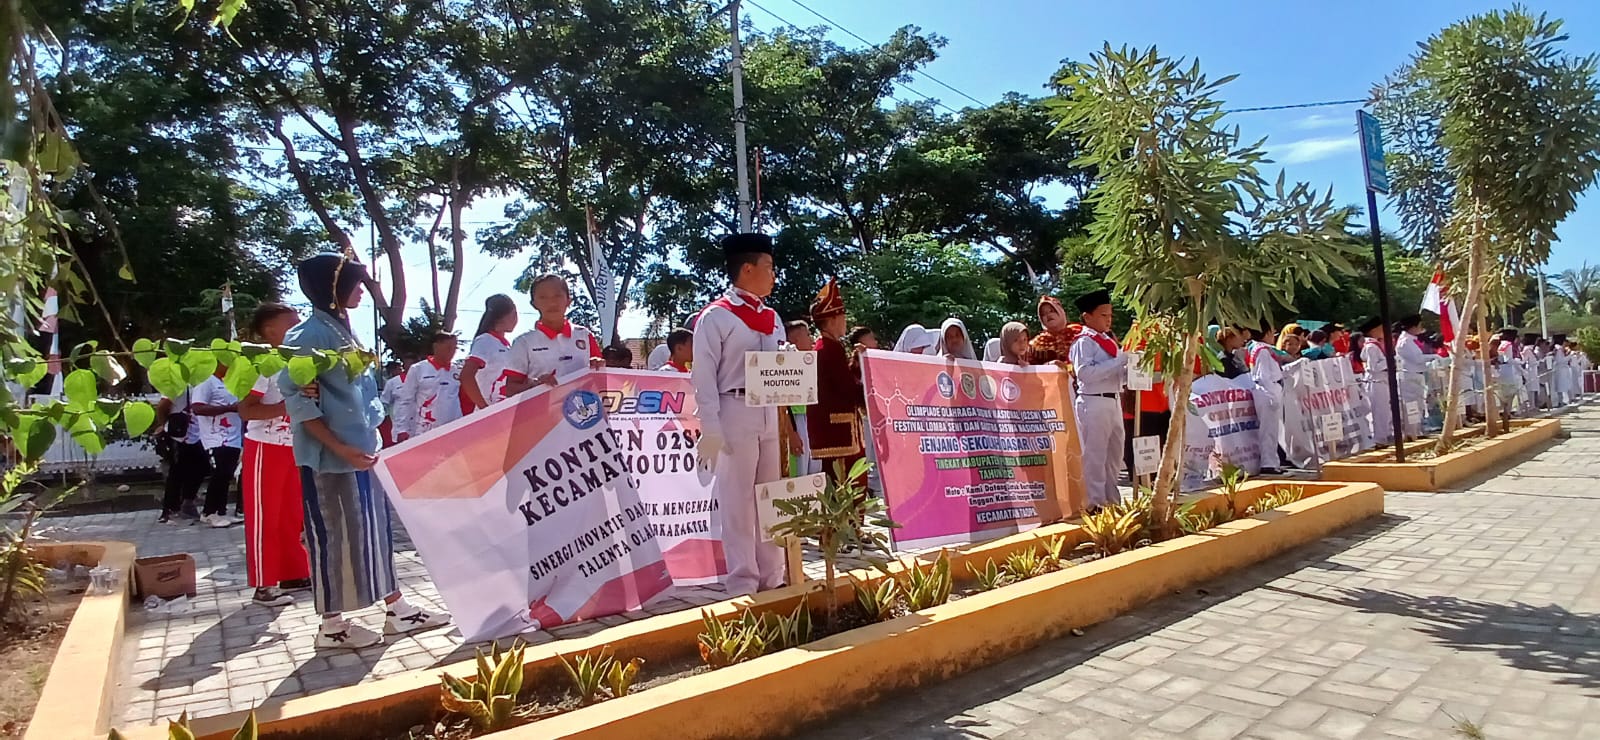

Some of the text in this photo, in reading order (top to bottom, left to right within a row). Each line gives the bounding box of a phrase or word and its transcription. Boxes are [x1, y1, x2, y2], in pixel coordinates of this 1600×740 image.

[760, 369, 804, 377] KECAMATAN
[763, 379, 801, 387] MOUTONG
[906, 406, 941, 417] OLIMPIADE
[941, 407, 977, 417] OLAHRAGA
[1042, 410, 1056, 419] DAN
[894, 420, 925, 431] FESTIVAL
[926, 421, 947, 431] LOMBA
[948, 421, 963, 431] SENI
[964, 421, 980, 432] DAN
[1018, 423, 1048, 433] NASIONAL
[919, 437, 960, 453] JENJANG
[1001, 438, 1030, 451] DASAR
[935, 458, 960, 469] TINGKAT
[966, 485, 982, 493] Kami
[984, 483, 1007, 493] Datang
[530, 544, 575, 580] SINERGI
[575, 514, 625, 553] INOVATIF
[578, 540, 632, 577] TALENTA
